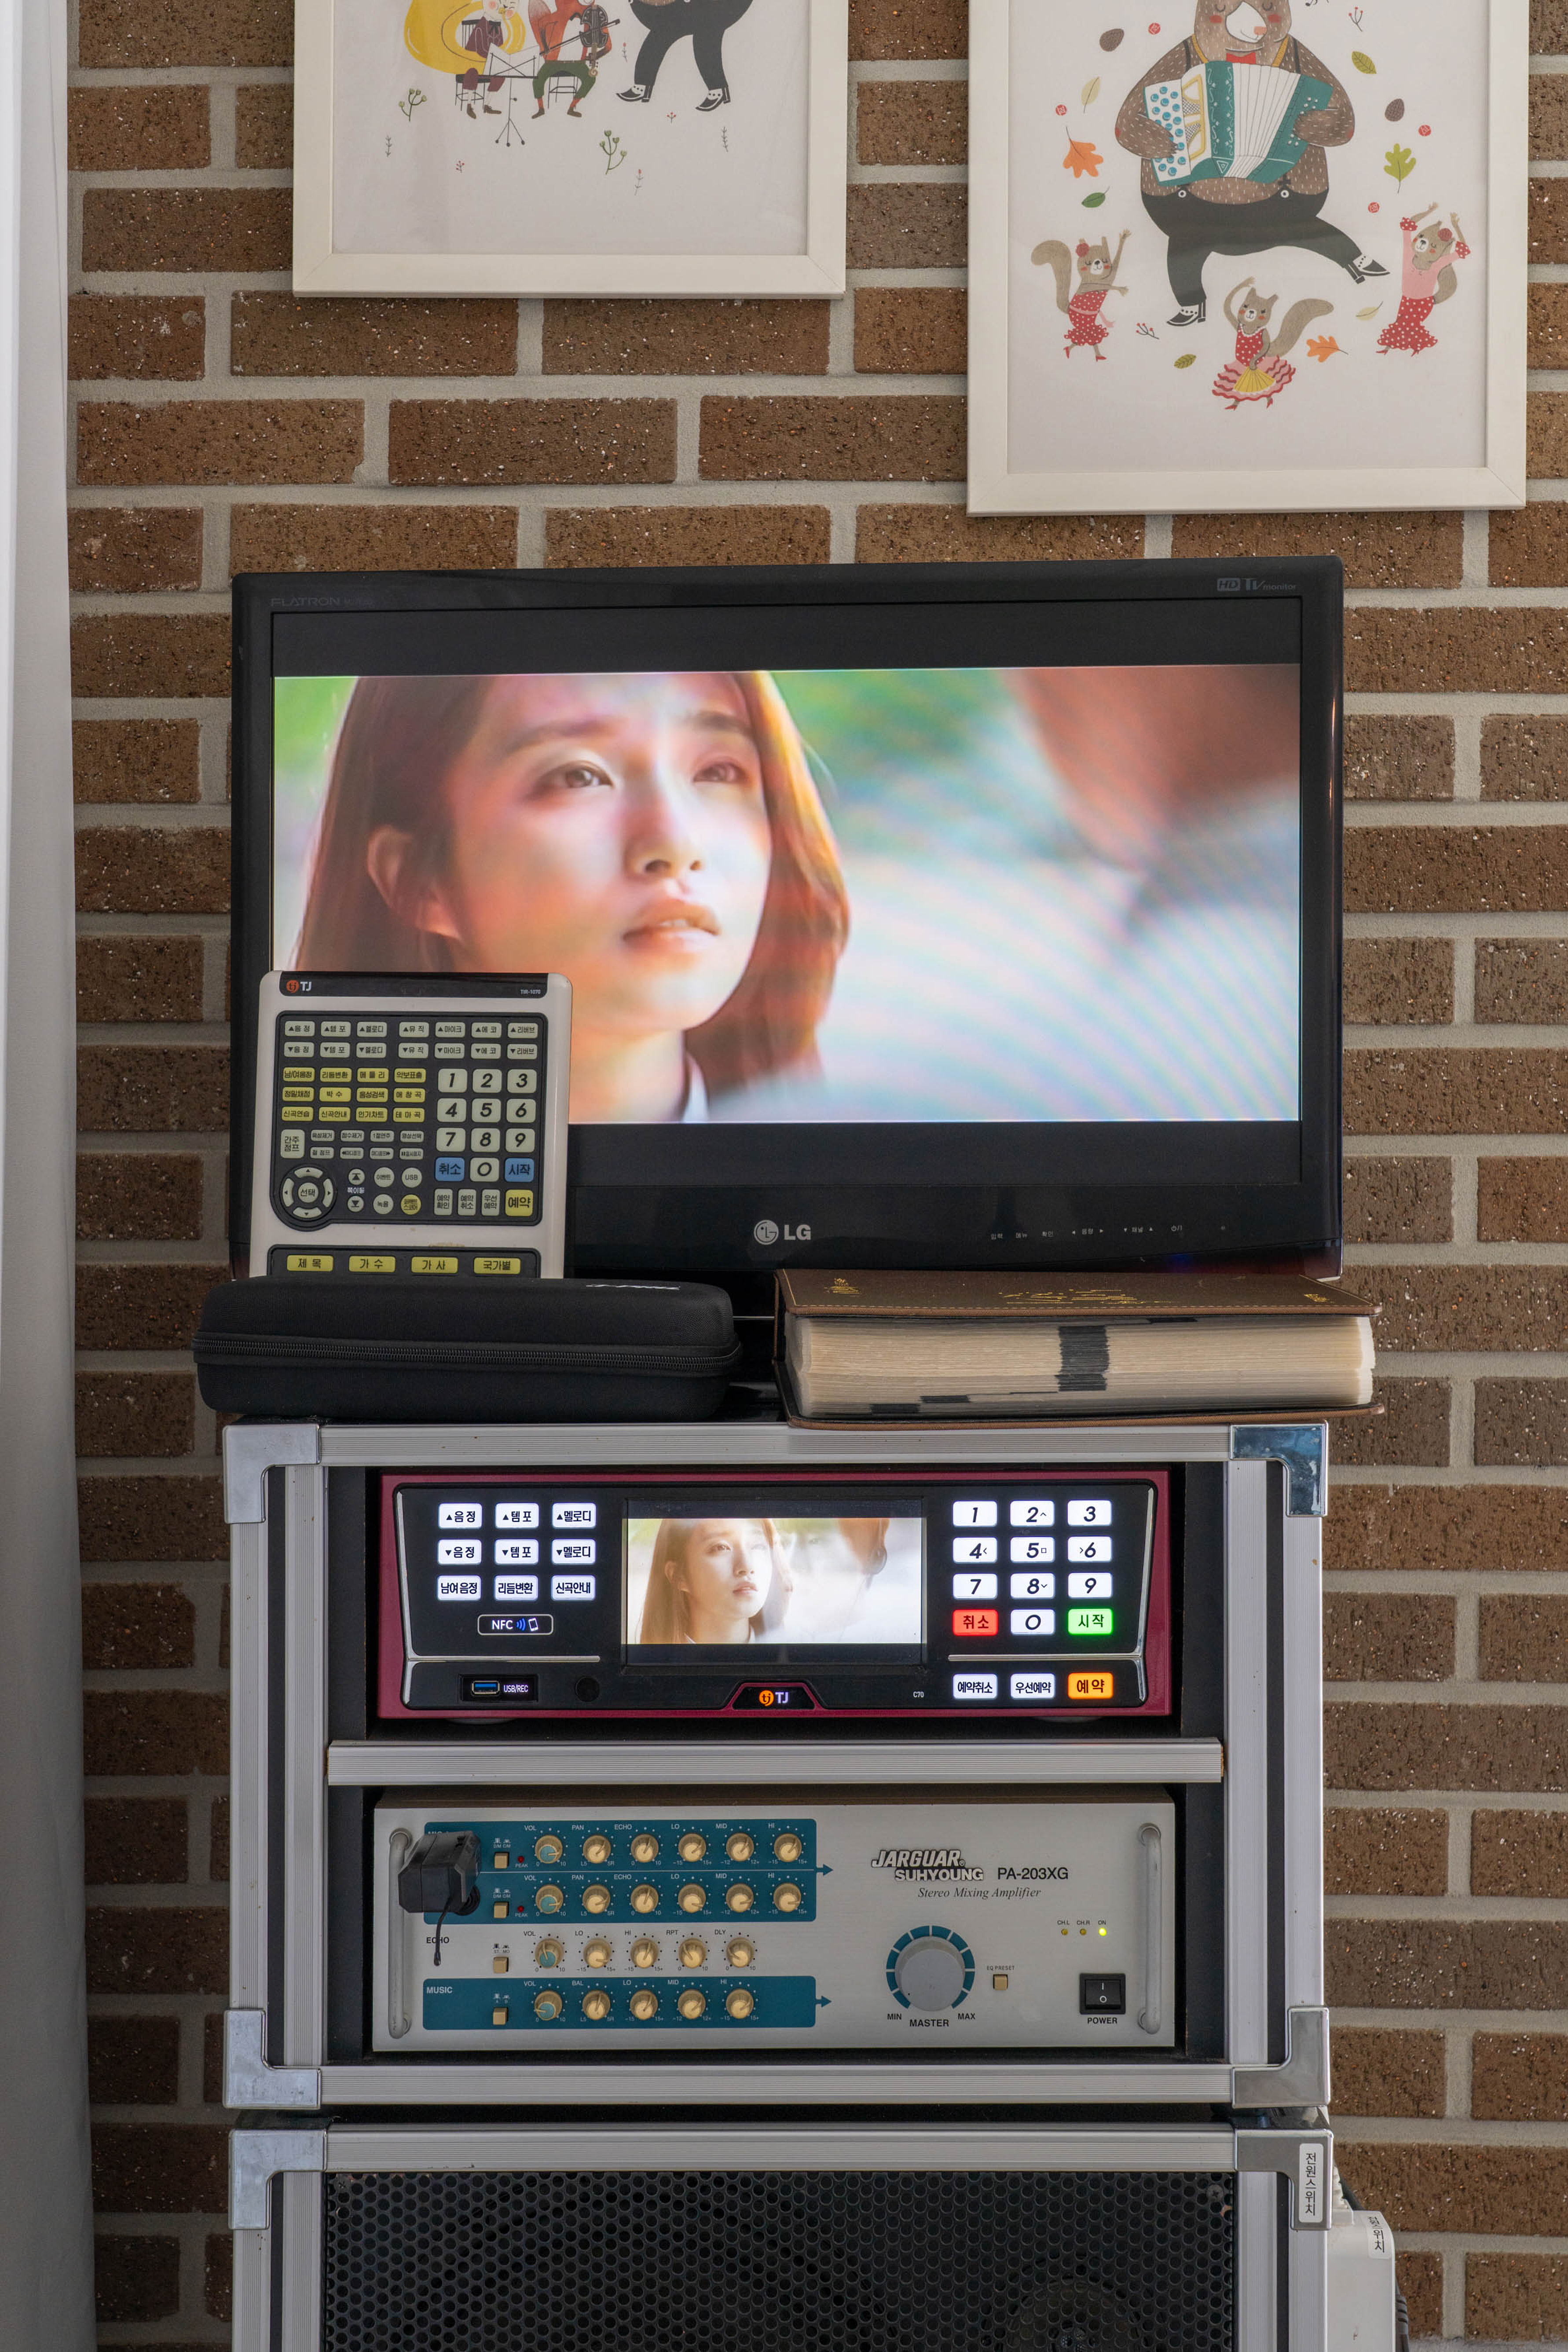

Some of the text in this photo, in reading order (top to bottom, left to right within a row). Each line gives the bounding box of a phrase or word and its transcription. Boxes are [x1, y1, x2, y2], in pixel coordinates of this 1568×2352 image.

[300, 981, 312, 991] TJ
[449, 1073, 455, 1088] 1
[480, 1073, 493, 1088] 2
[516, 1073, 528, 1088] 3
[445, 1102, 458, 1117] 4
[480, 1103, 492, 1117] 5
[515, 1102, 527, 1118] 6
[446, 1132, 456, 1147] 7
[480, 1132, 491, 1147] 8
[515, 1132, 526, 1147] 9
[439, 1163, 461, 1175] 취소
[477, 1162, 492, 1177] 0
[508, 1164, 531, 1175] 시작
[300, 1189, 315, 1197] 선택
[508, 1197, 531, 1209] 예약
[784, 1224, 811, 1240] LG
[483, 1260, 511, 1271] 국가별
[564, 1510, 591, 1522] 멜로디
[972, 1507, 978, 1523] 1
[1026, 1507, 1039, 1523] 2
[1083, 1506, 1096, 1522] 3
[563, 1546, 590, 1558] 멜로디
[969, 1543, 982, 1559] 4
[1026, 1542, 1039, 1558] 5
[1084, 1542, 1096, 1558] 6
[498, 1582, 533, 1594] 리듬변환
[555, 1582, 591, 1594] 신곡안내
[970, 1579, 982, 1595] 7
[1027, 1578, 1040, 1594] 8
[1085, 1577, 1097, 1594] 9
[492, 1620, 513, 1630] NFC
[963, 1615, 989, 1629] 취소
[1025, 1614, 1041, 1630] 0
[1078, 1614, 1104, 1628] 시작
[504, 1684, 528, 1693] USB/REC
[957, 1682, 993, 1693] 예약취소
[1015, 1682, 1051, 1694] 우선예약
[1077, 1679, 1105, 1694] 예약
[775, 1692, 788, 1704] TJ
[871, 1850, 961, 1868] JARGUAR
[895, 1868, 983, 1881] SUHYOUNG
[998, 1867, 1068, 1880] PA-203XG
[918, 1887, 1041, 1900] Stereo Mixing Amplifier
[909, 2019, 949, 2027] MASTER
[1305, 2152, 1316, 2216] 전원스위치
